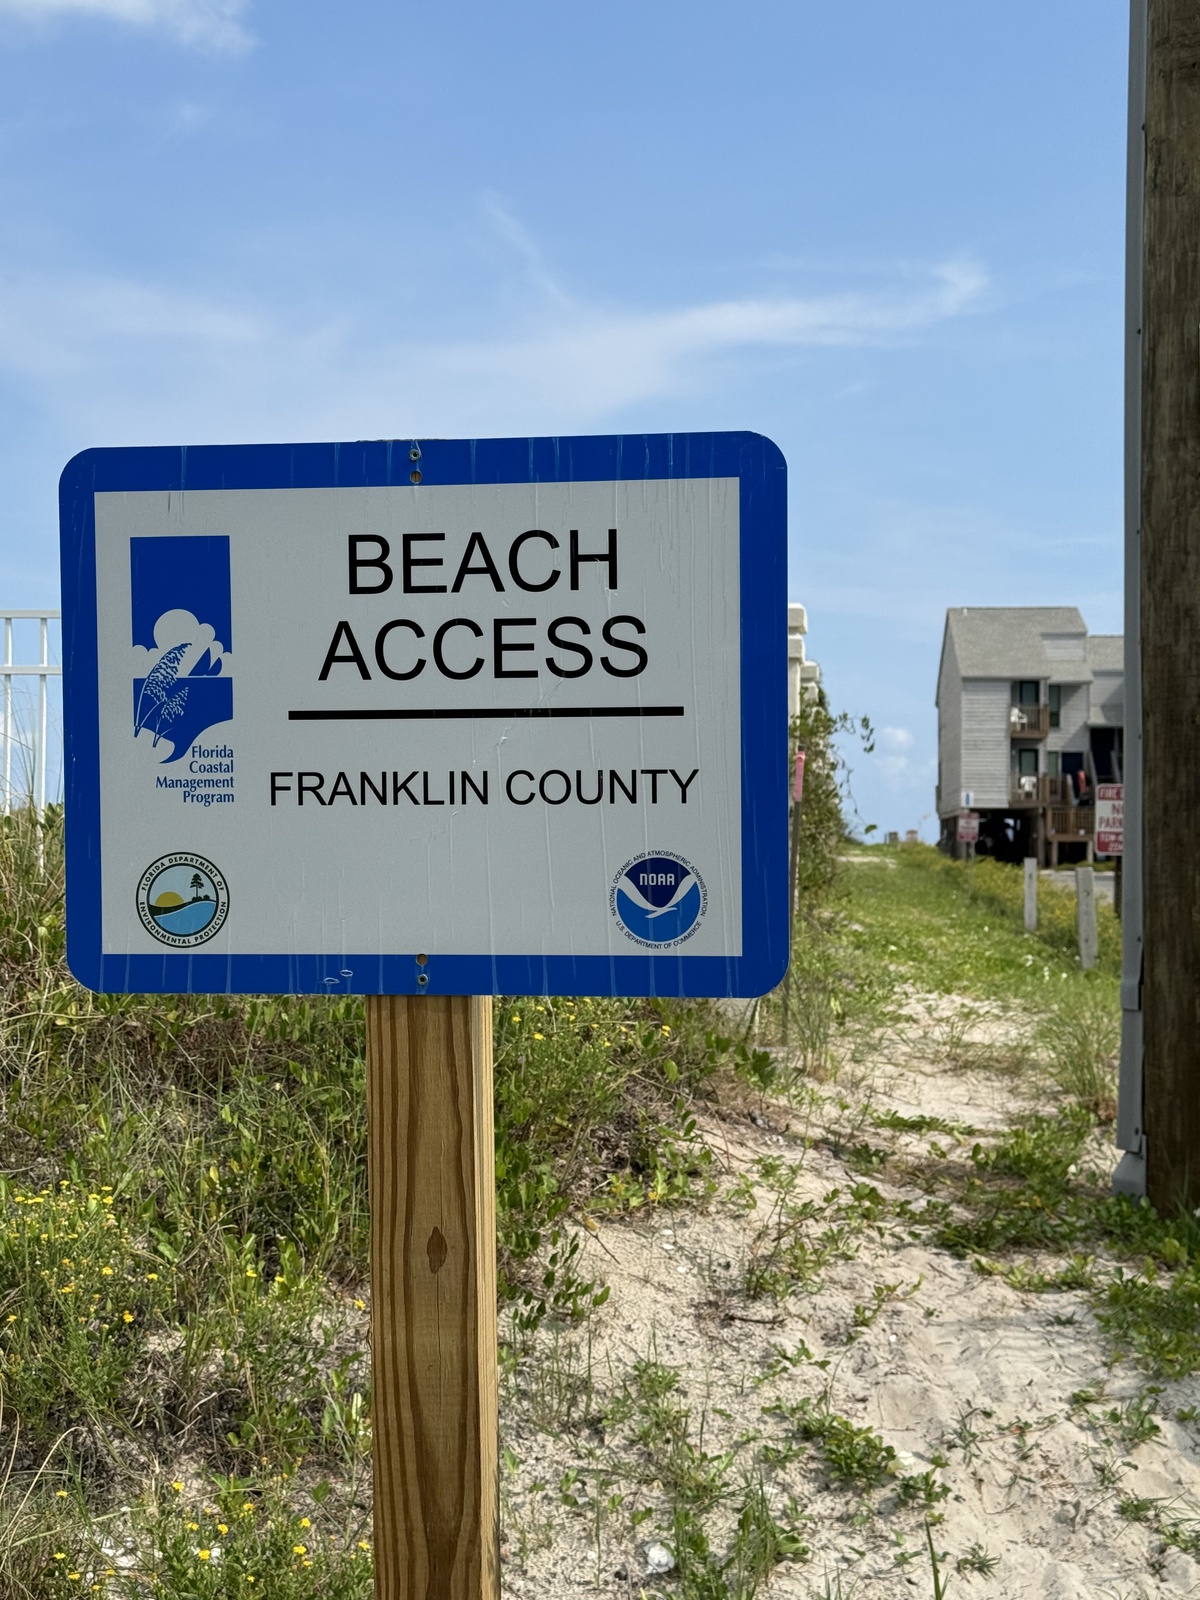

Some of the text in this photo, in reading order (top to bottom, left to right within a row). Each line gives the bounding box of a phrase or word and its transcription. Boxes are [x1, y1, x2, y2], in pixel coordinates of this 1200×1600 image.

[348, 528, 618, 595] BEACH
[318, 614, 649, 681] ACCESS
[189, 759, 234, 774] Coastal
[191, 744, 234, 759] Florida
[155, 776, 235, 793] Management
[183, 790, 235, 807] Program
[270, 768, 700, 807] FRANKLIN COUNTY
[141, 856, 225, 891] FLORIDA DEPARTMENT OF
[608, 850, 708, 917] NATIONAL OCEANIC AND ATMOSPHERIC ADMINISTRATION
[639, 873, 675, 886] NOAA
[139, 901, 227, 945] ENVIRONMENTAL PROTECTION
[615, 920, 702, 950] U.S. DEPARTMENT OF COMMERCE
